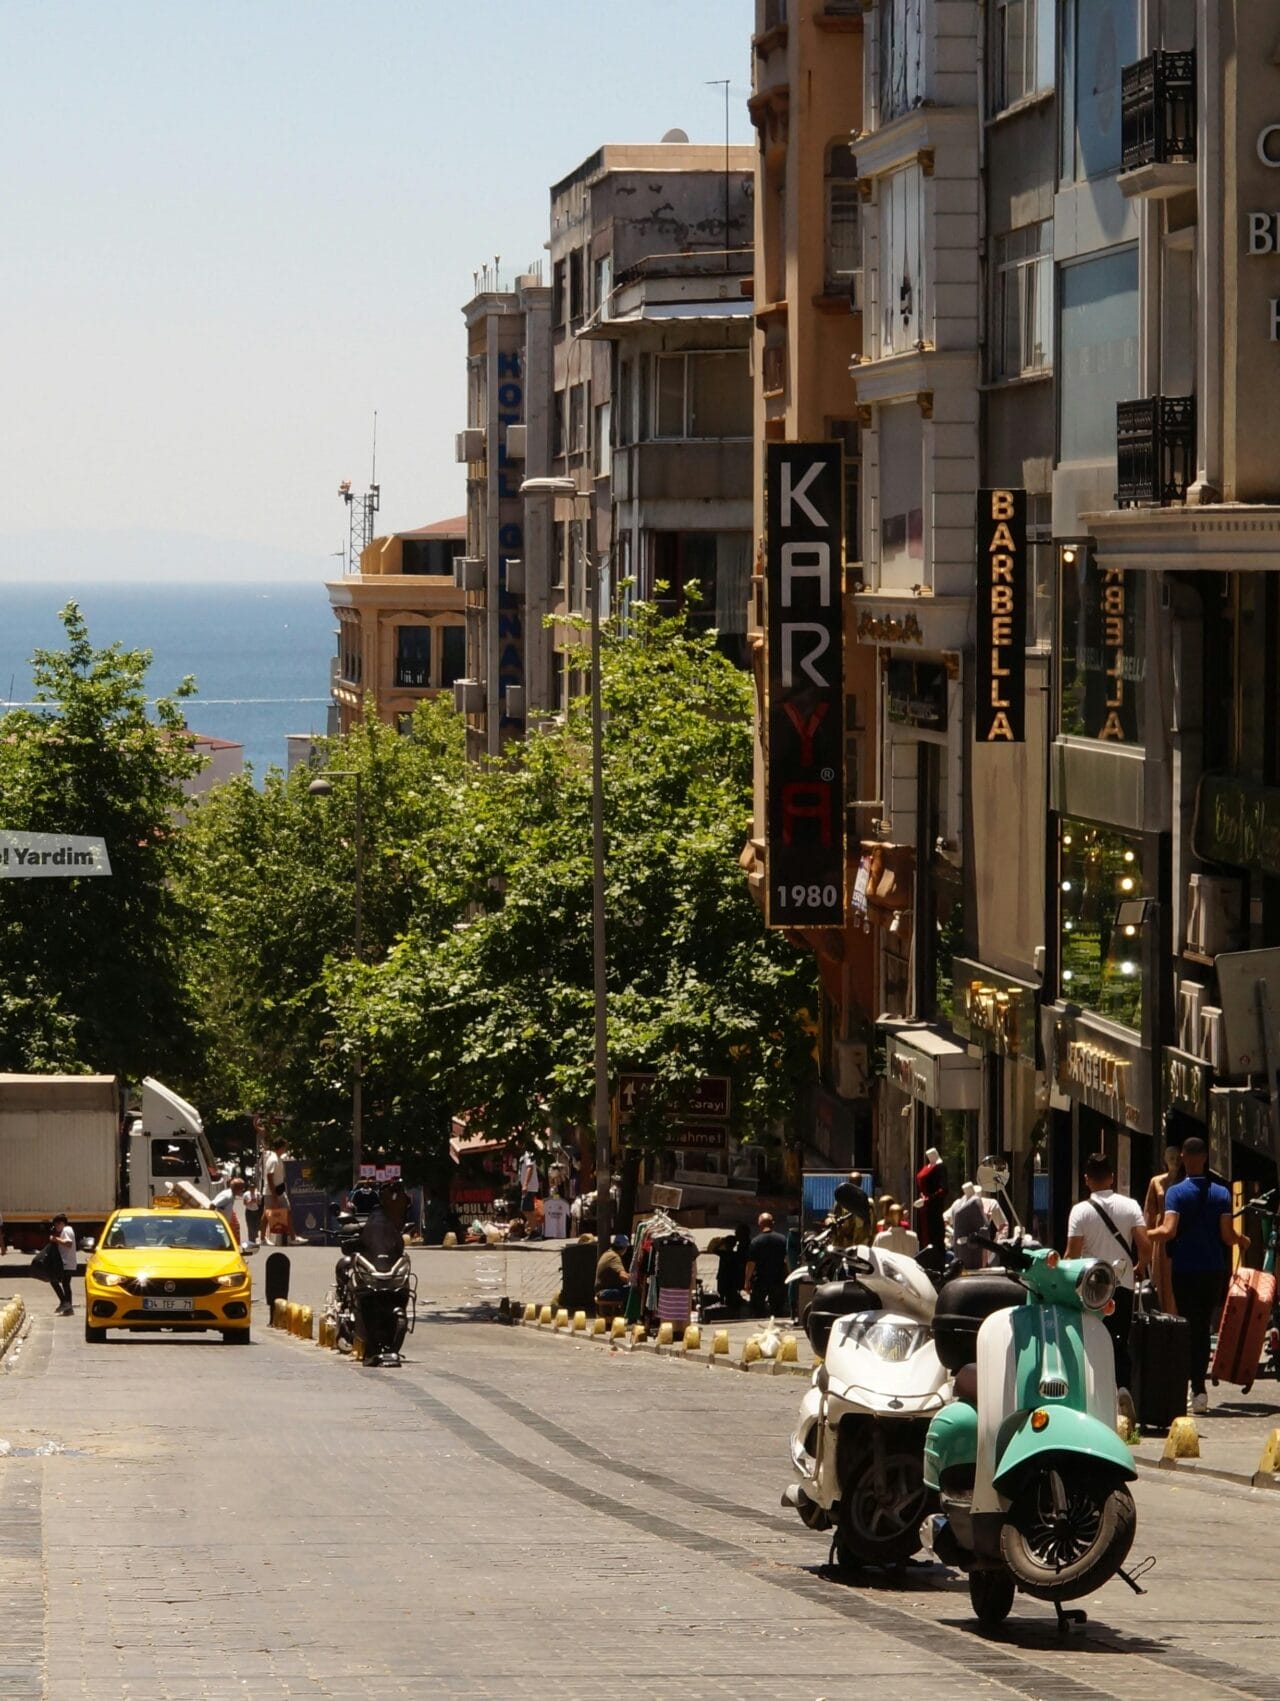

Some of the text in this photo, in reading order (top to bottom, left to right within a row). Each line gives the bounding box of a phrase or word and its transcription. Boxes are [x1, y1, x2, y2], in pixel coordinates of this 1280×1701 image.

[779, 461, 833, 848] KARYA
[987, 490, 1017, 741] BARBELLA
[776, 884, 839, 909] 1980
